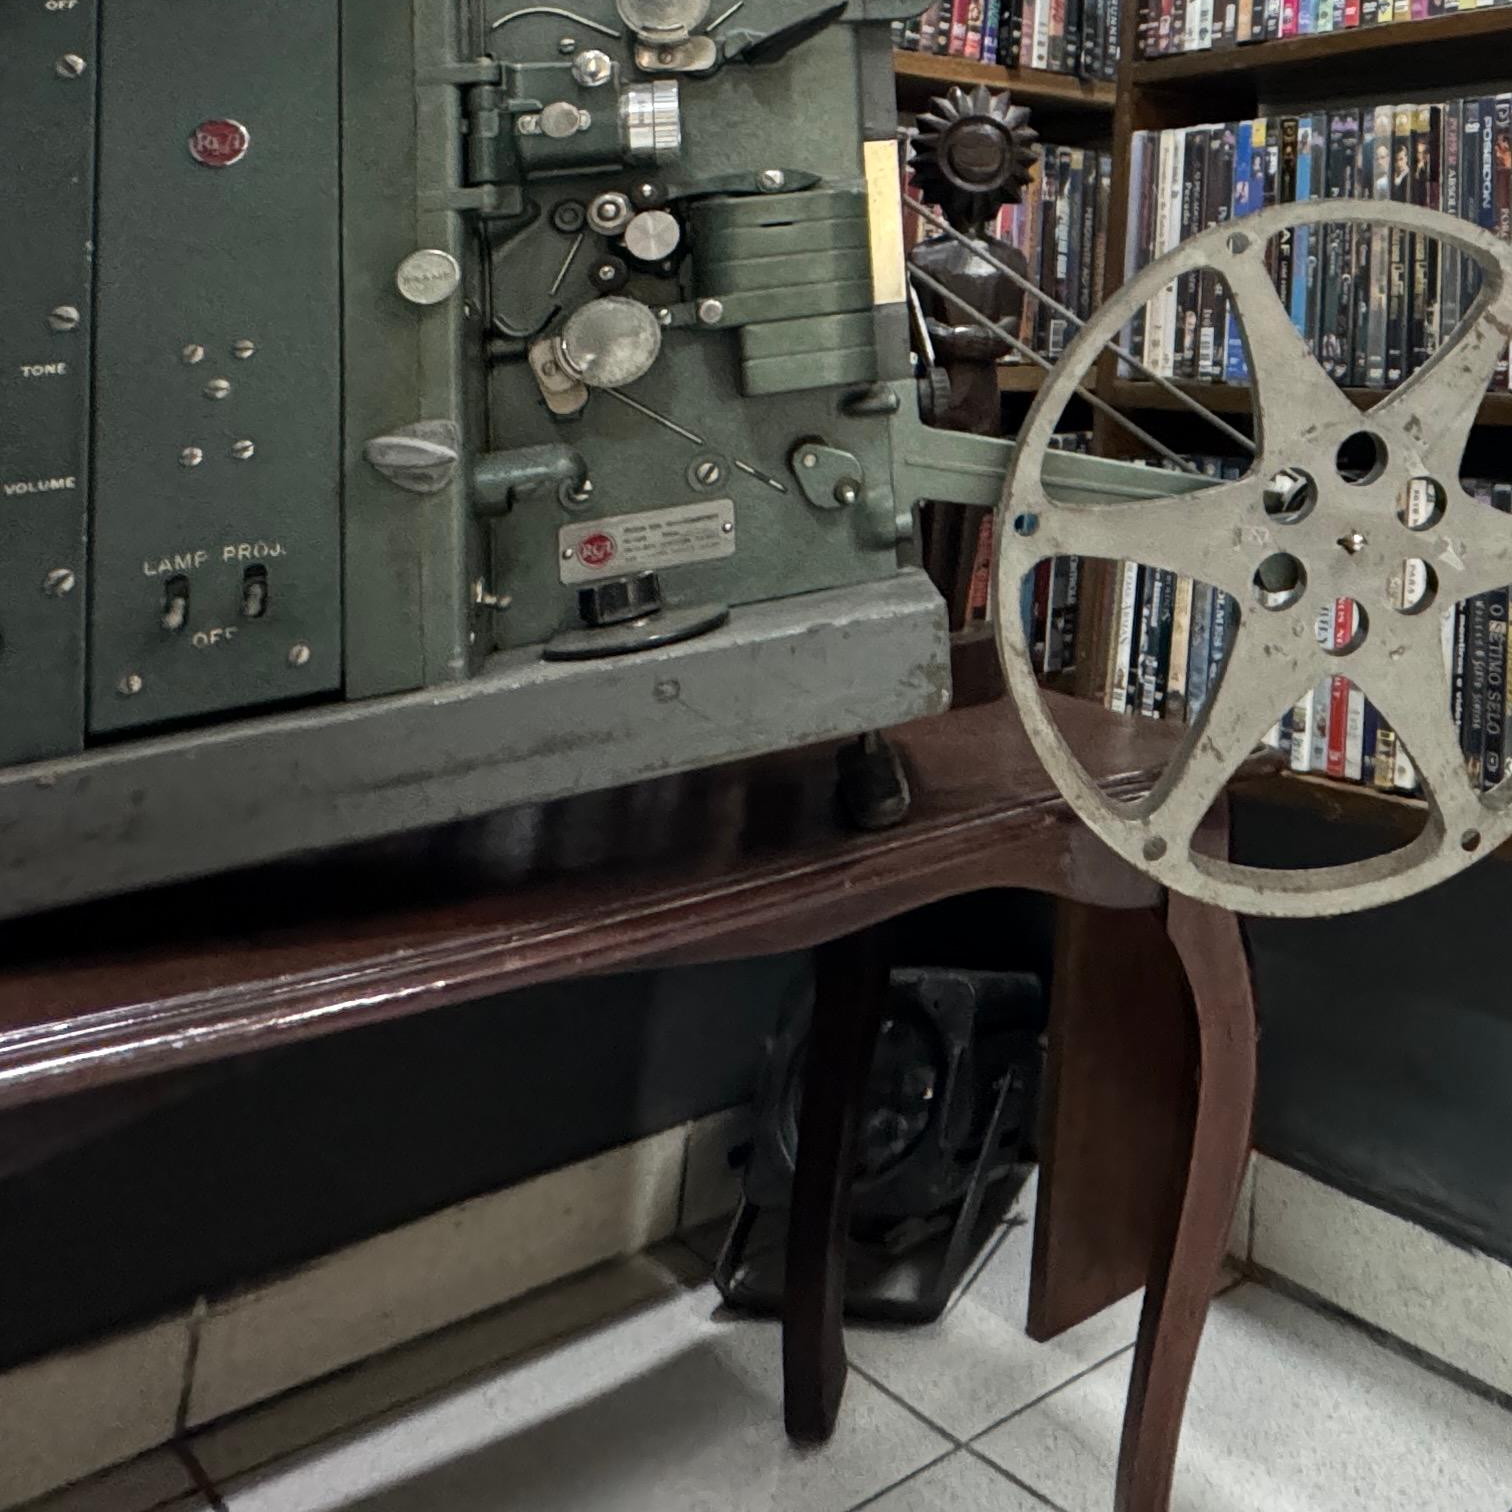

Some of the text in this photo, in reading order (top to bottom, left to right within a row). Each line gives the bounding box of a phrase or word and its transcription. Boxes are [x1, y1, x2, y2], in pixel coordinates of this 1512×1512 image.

[45, 0, 78, 11] OFF
[1482, 115, 1492, 208] POSEIDON
[21, 362, 67, 377] TONE
[4, 476, 76, 495] VOLUME
[144, 551, 208, 576] LAMP
[1491, 604, 1504, 615] O
[193, 627, 239, 648] OFF
[1488, 691, 1501, 734] SELO
